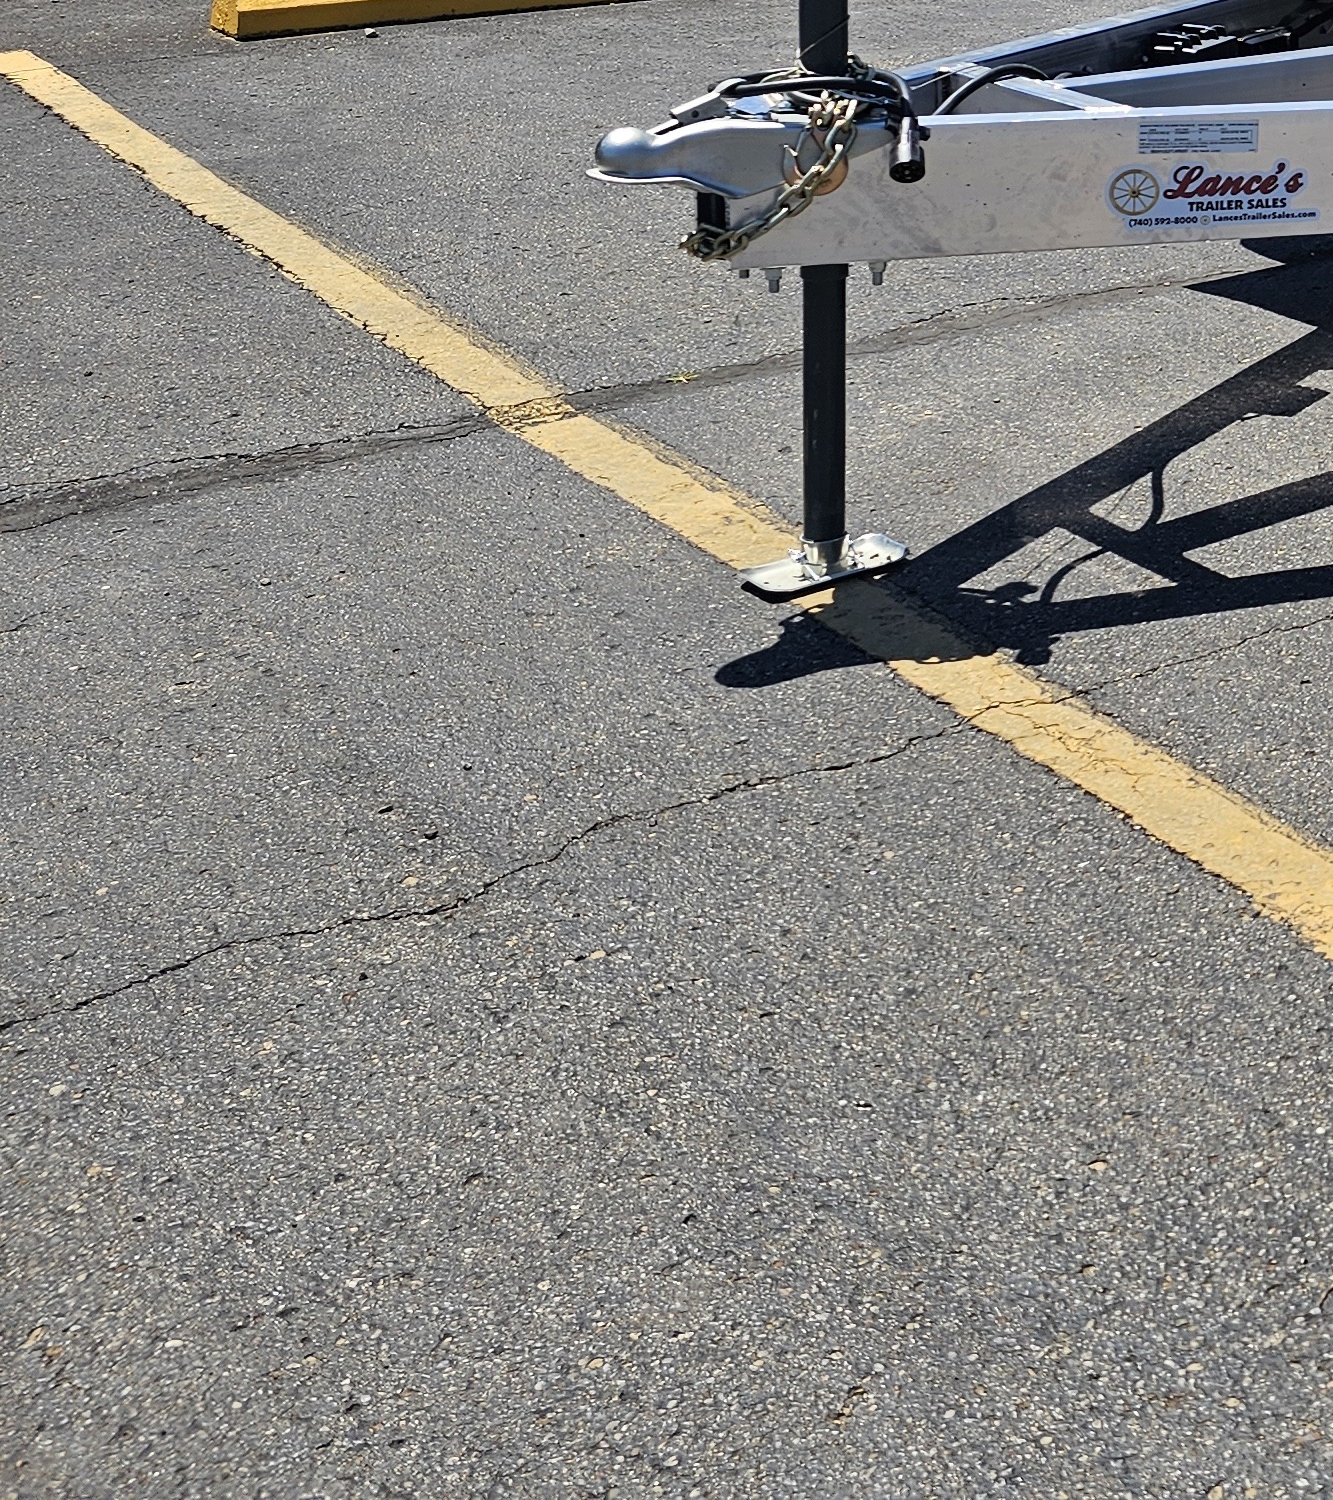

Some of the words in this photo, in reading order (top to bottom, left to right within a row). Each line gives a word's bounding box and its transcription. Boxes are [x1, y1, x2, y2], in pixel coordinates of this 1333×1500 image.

[1163, 162, 1303, 200] Lance's
[1187, 201, 1243, 212] TRAILER
[1247, 198, 1287, 210] SALES
[1128, 218, 1153, 228] (740)
[1154, 216, 1198, 226] 592-8000
[1212, 211, 1317, 223] LancesTrailerSales.com
